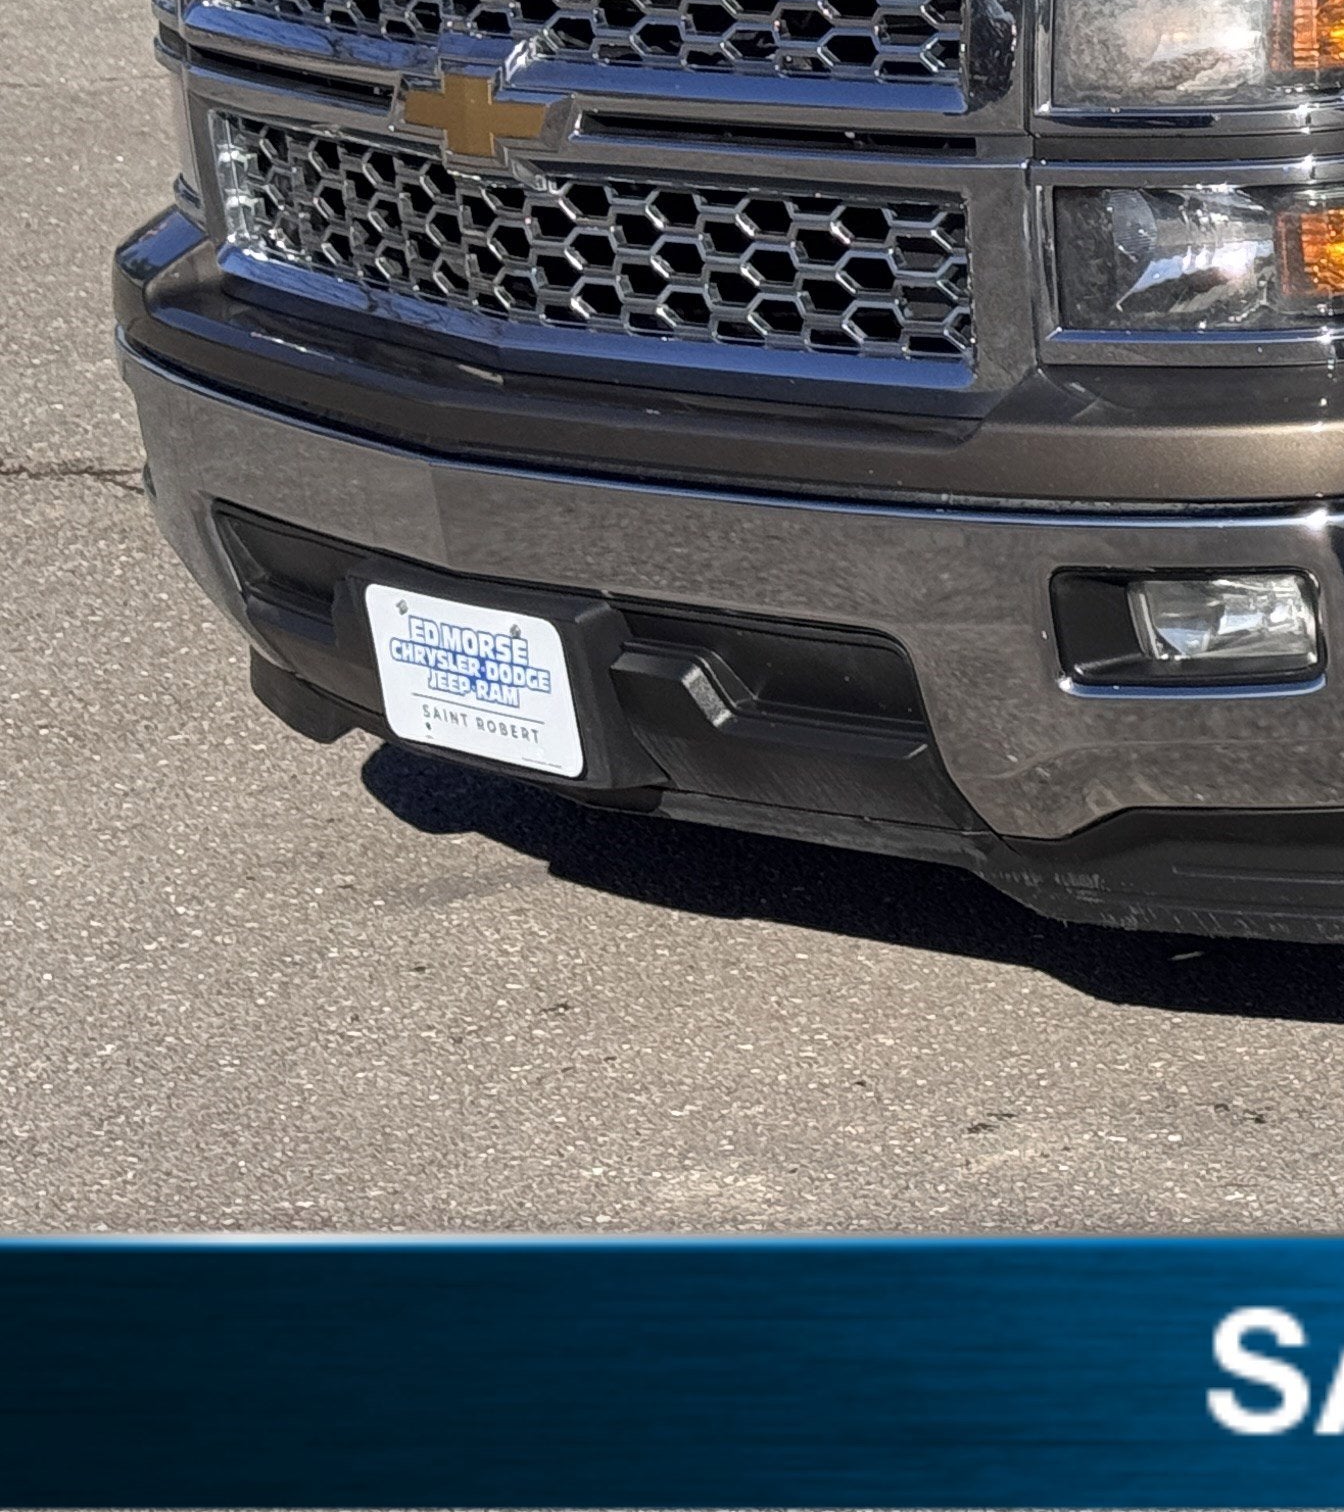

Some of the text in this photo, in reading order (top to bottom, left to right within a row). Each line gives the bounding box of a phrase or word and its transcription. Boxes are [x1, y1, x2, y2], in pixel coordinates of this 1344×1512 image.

[408, 615, 529, 666] ED MORSE
[422, 703, 540, 744] SAINT ROBERT
